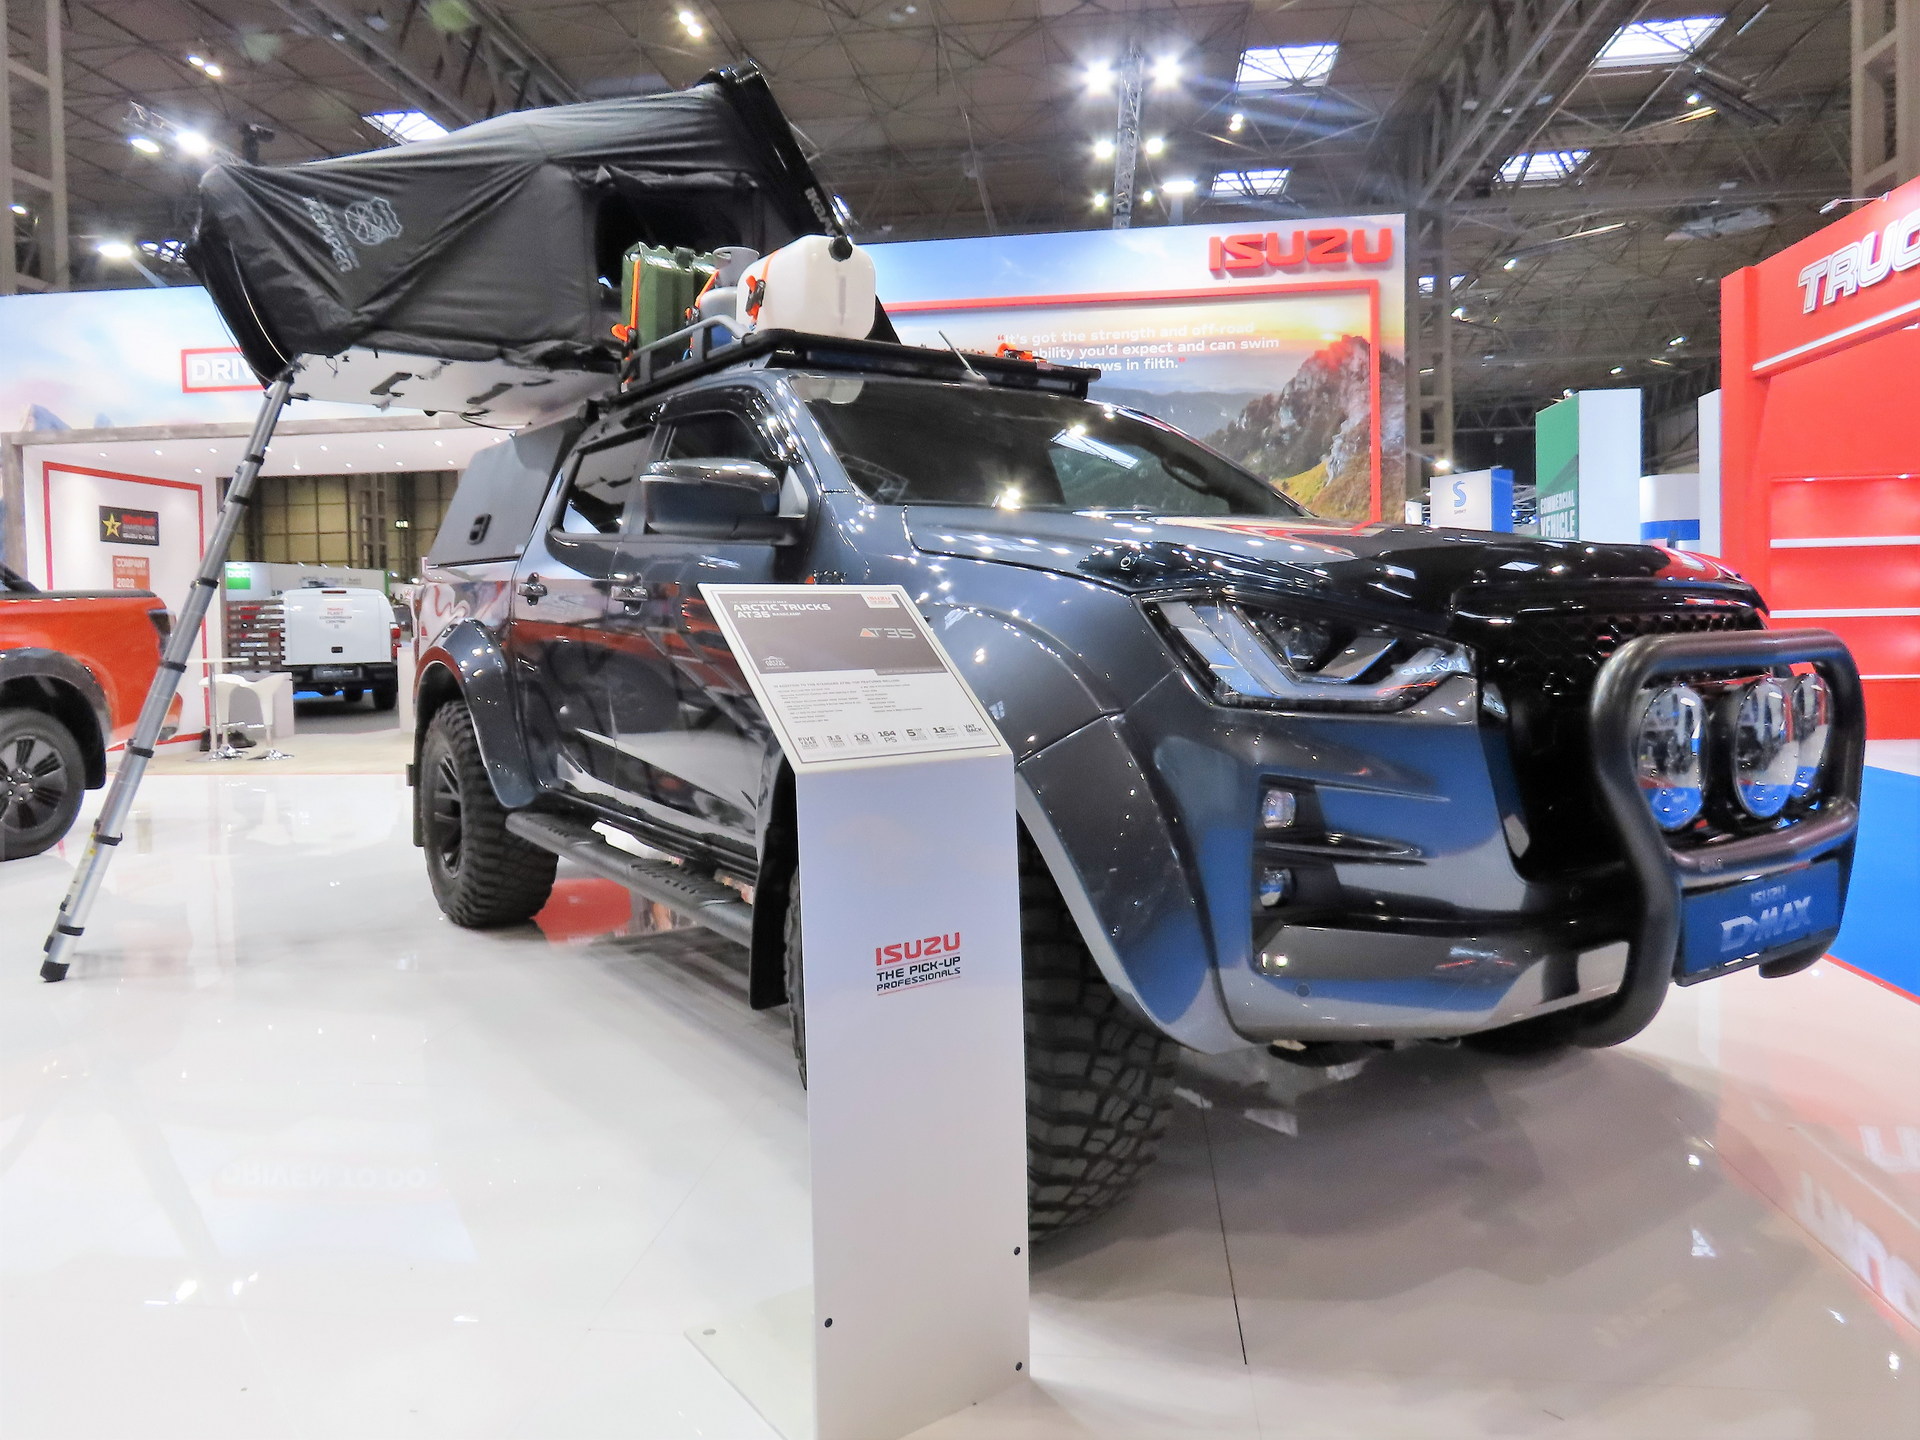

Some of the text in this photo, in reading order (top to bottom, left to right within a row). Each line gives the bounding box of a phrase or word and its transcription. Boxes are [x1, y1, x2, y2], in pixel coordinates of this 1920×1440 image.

[1209, 228, 1392, 271] ISUZU
[1032, 334, 1056, 346] got
[1061, 330, 1085, 342] the
[1091, 326, 1156, 342] strength
[1160, 325, 1188, 337] and
[1192, 322, 1254, 336] off-road
[1079, 344, 1118, 359] you’d
[1122, 341, 1173, 357] expect
[1178, 340, 1205, 352] and
[1210, 341, 1236, 351] can
[1240, 337, 1280, 349] swim
[1126, 358, 1139, 371] in
[1541, 489, 1575, 515] COMMERCIAL
[1541, 510, 1575, 538] VEHICLE
[733, 603, 832, 612] ARCTIC TRUCKS
[737, 611, 771, 619] AT35
[860, 627, 916, 639] AT35
[906, 728, 917, 737] 5
[875, 932, 960, 966] ISUZU
[876, 956, 961, 981] THE PICK-UP
[876, 967, 961, 991] PROFESSIONALS
